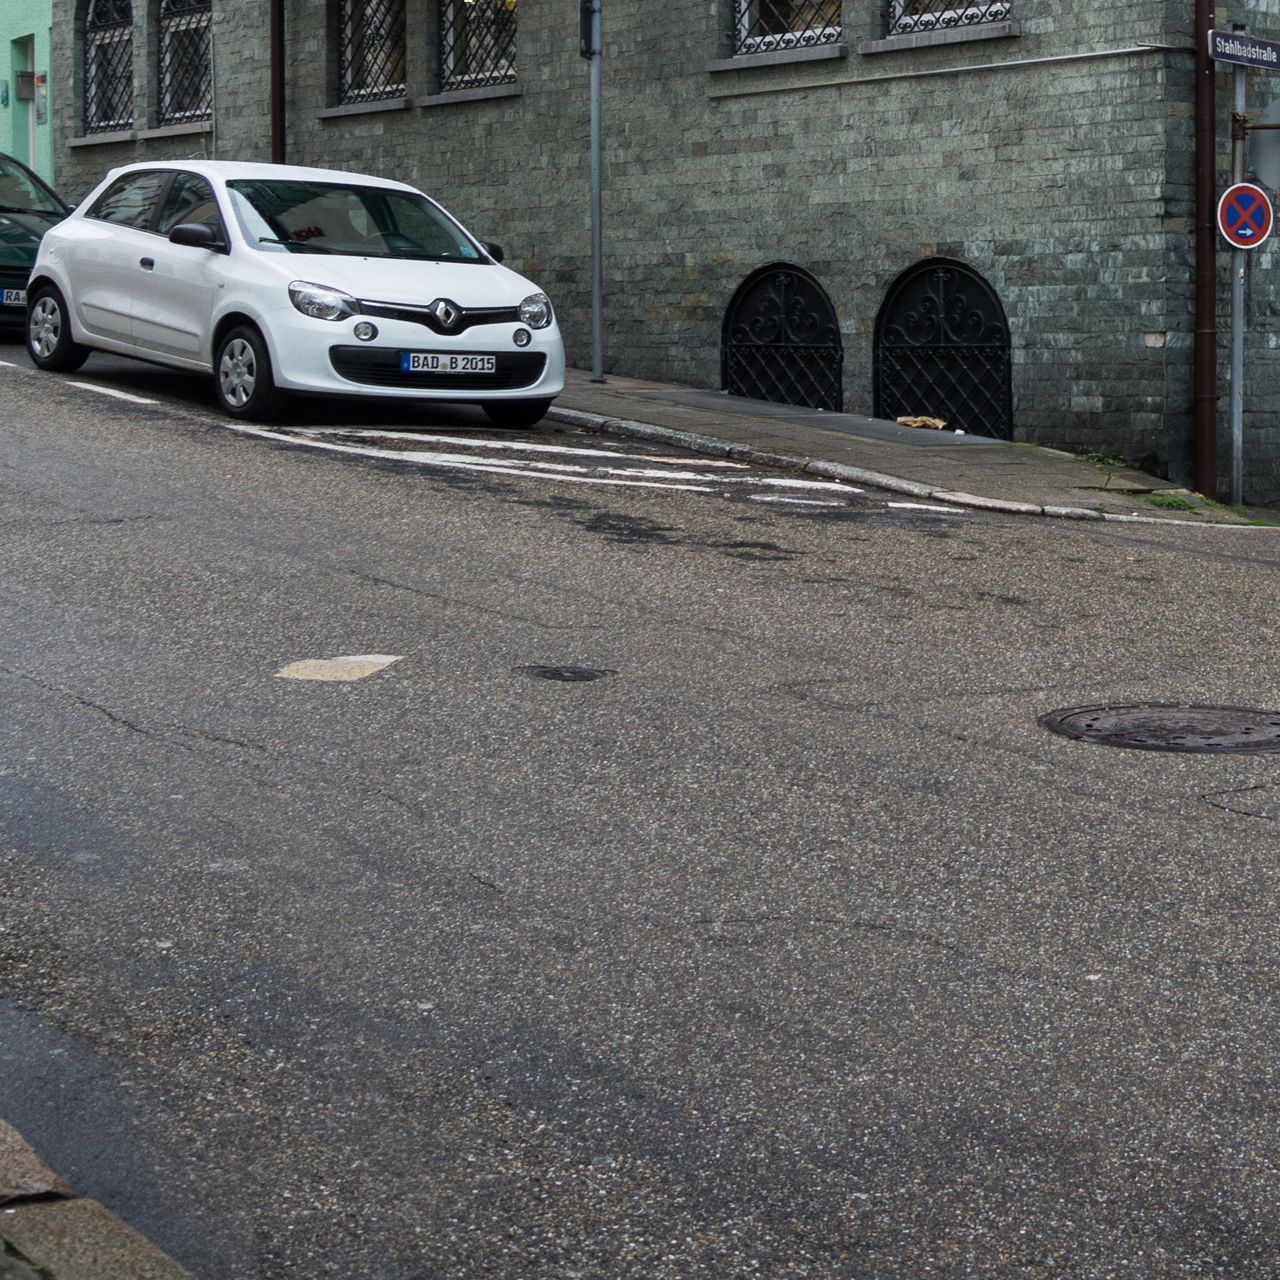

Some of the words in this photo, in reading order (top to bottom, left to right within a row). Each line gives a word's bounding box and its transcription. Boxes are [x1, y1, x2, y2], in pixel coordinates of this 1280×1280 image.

[1215, 36, 1277, 63] Stahlbadstraße
[411, 355, 440, 370] BAD
[449, 356, 459, 370] B
[461, 357, 495, 371] 2015
